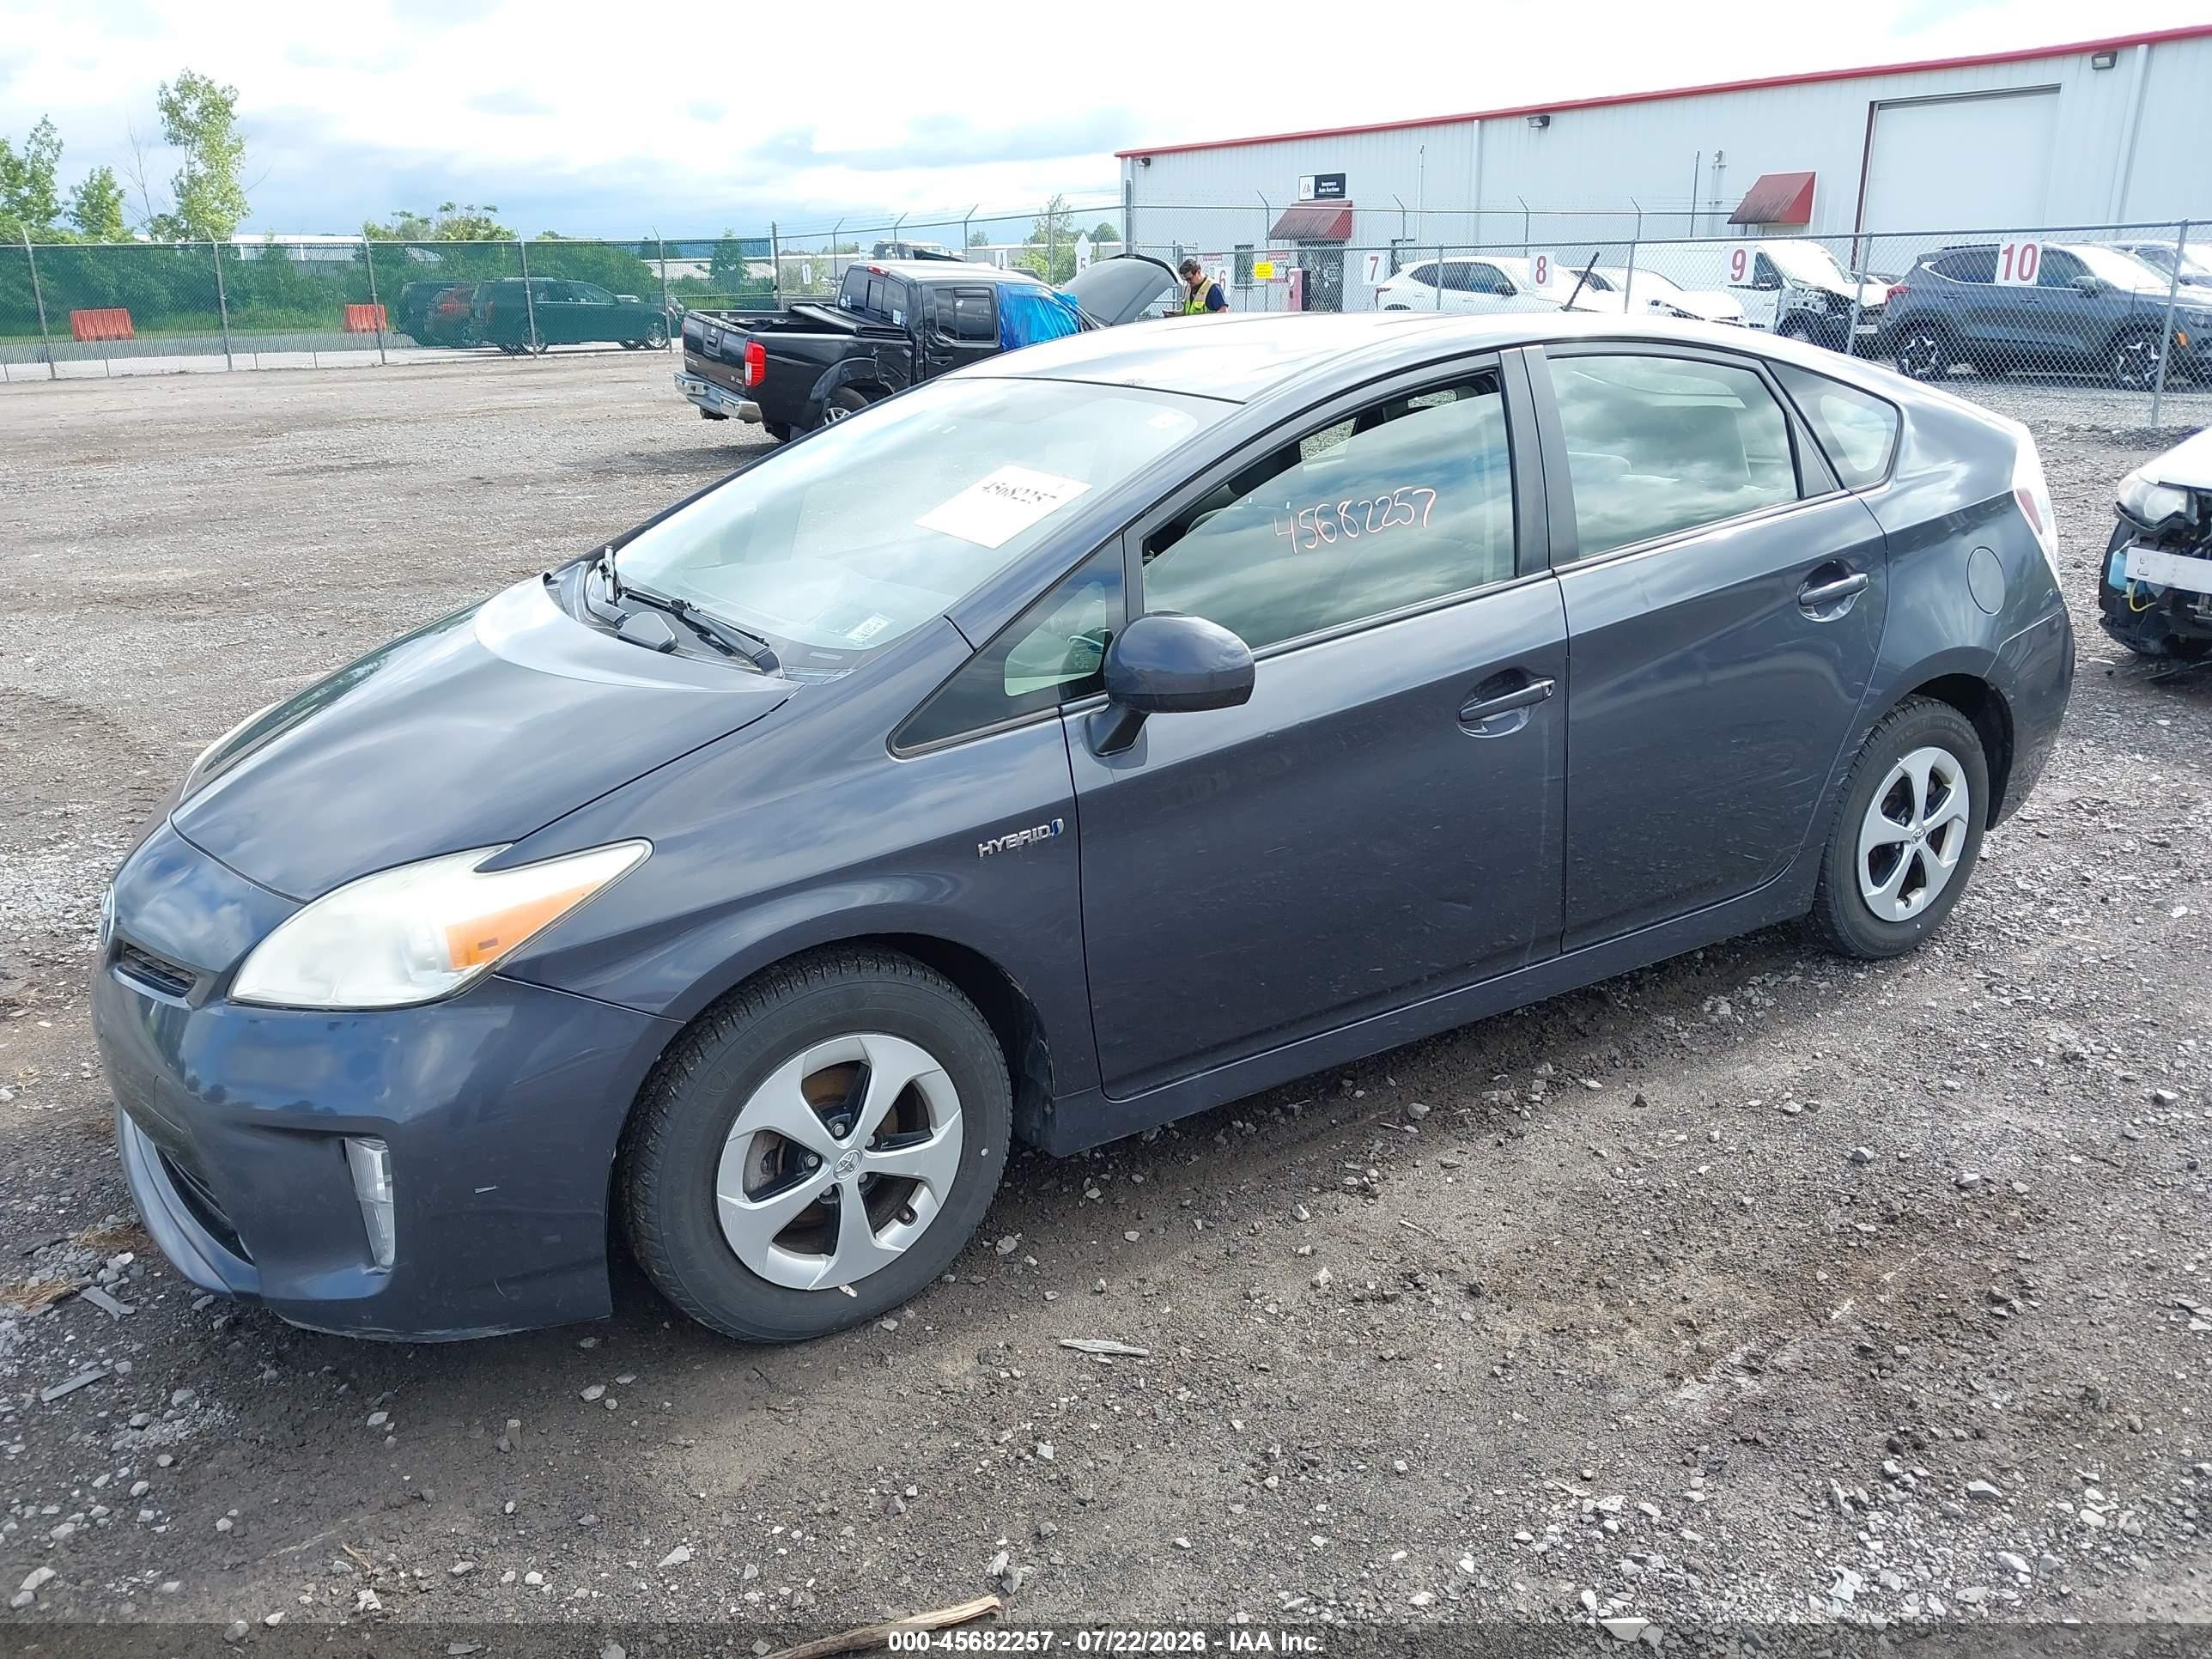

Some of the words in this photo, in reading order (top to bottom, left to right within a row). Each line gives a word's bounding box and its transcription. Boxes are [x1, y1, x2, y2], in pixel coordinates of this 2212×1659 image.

[1080, 258, 1086, 270] 5
[1370, 256, 1379, 282] 7
[1535, 255, 1547, 284] 8
[1731, 248, 1747, 282] 9
[2002, 244, 2038, 281] 10
[1219, 270, 1227, 292] 6
[1273, 486, 1437, 554] 45682257
[977, 824, 1051, 858] HYBRID
